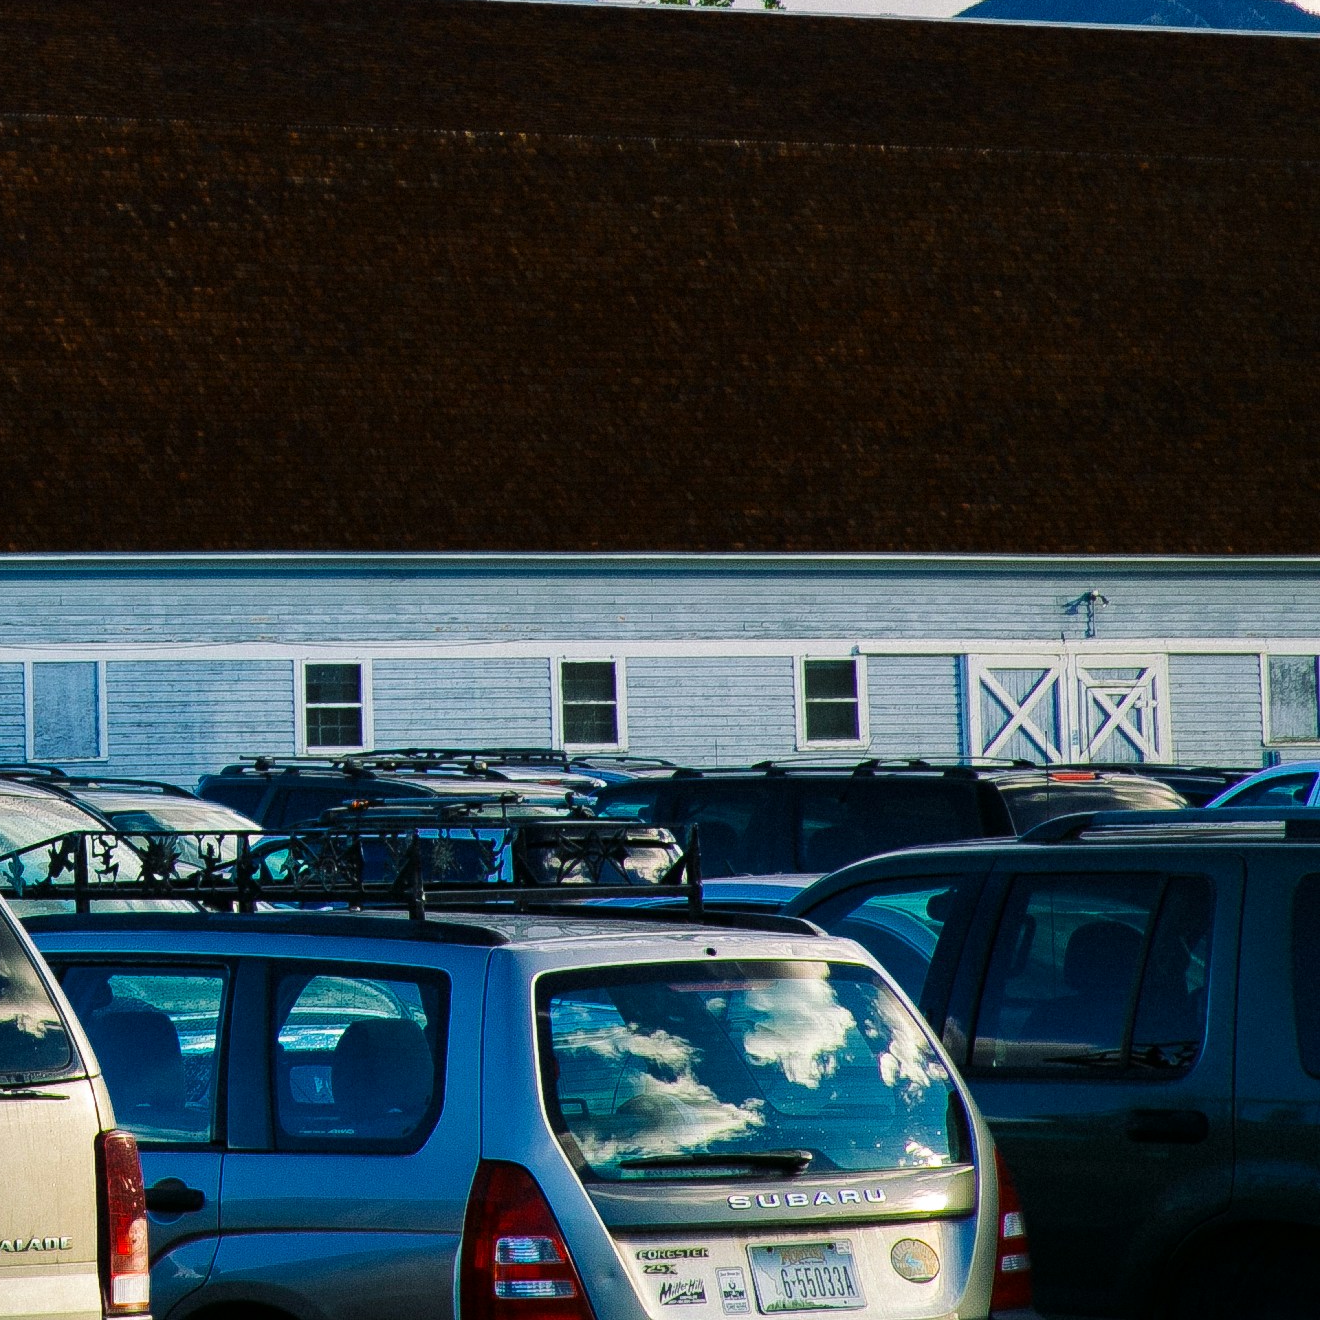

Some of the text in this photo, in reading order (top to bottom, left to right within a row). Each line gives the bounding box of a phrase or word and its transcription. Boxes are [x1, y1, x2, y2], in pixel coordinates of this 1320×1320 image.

[727, 1188, 887, 1210] SUBARU
[635, 1247, 710, 1260] FORESTER
[660, 1280, 687, 1302] Miller
[688, 1278, 704, 1294] Hill
